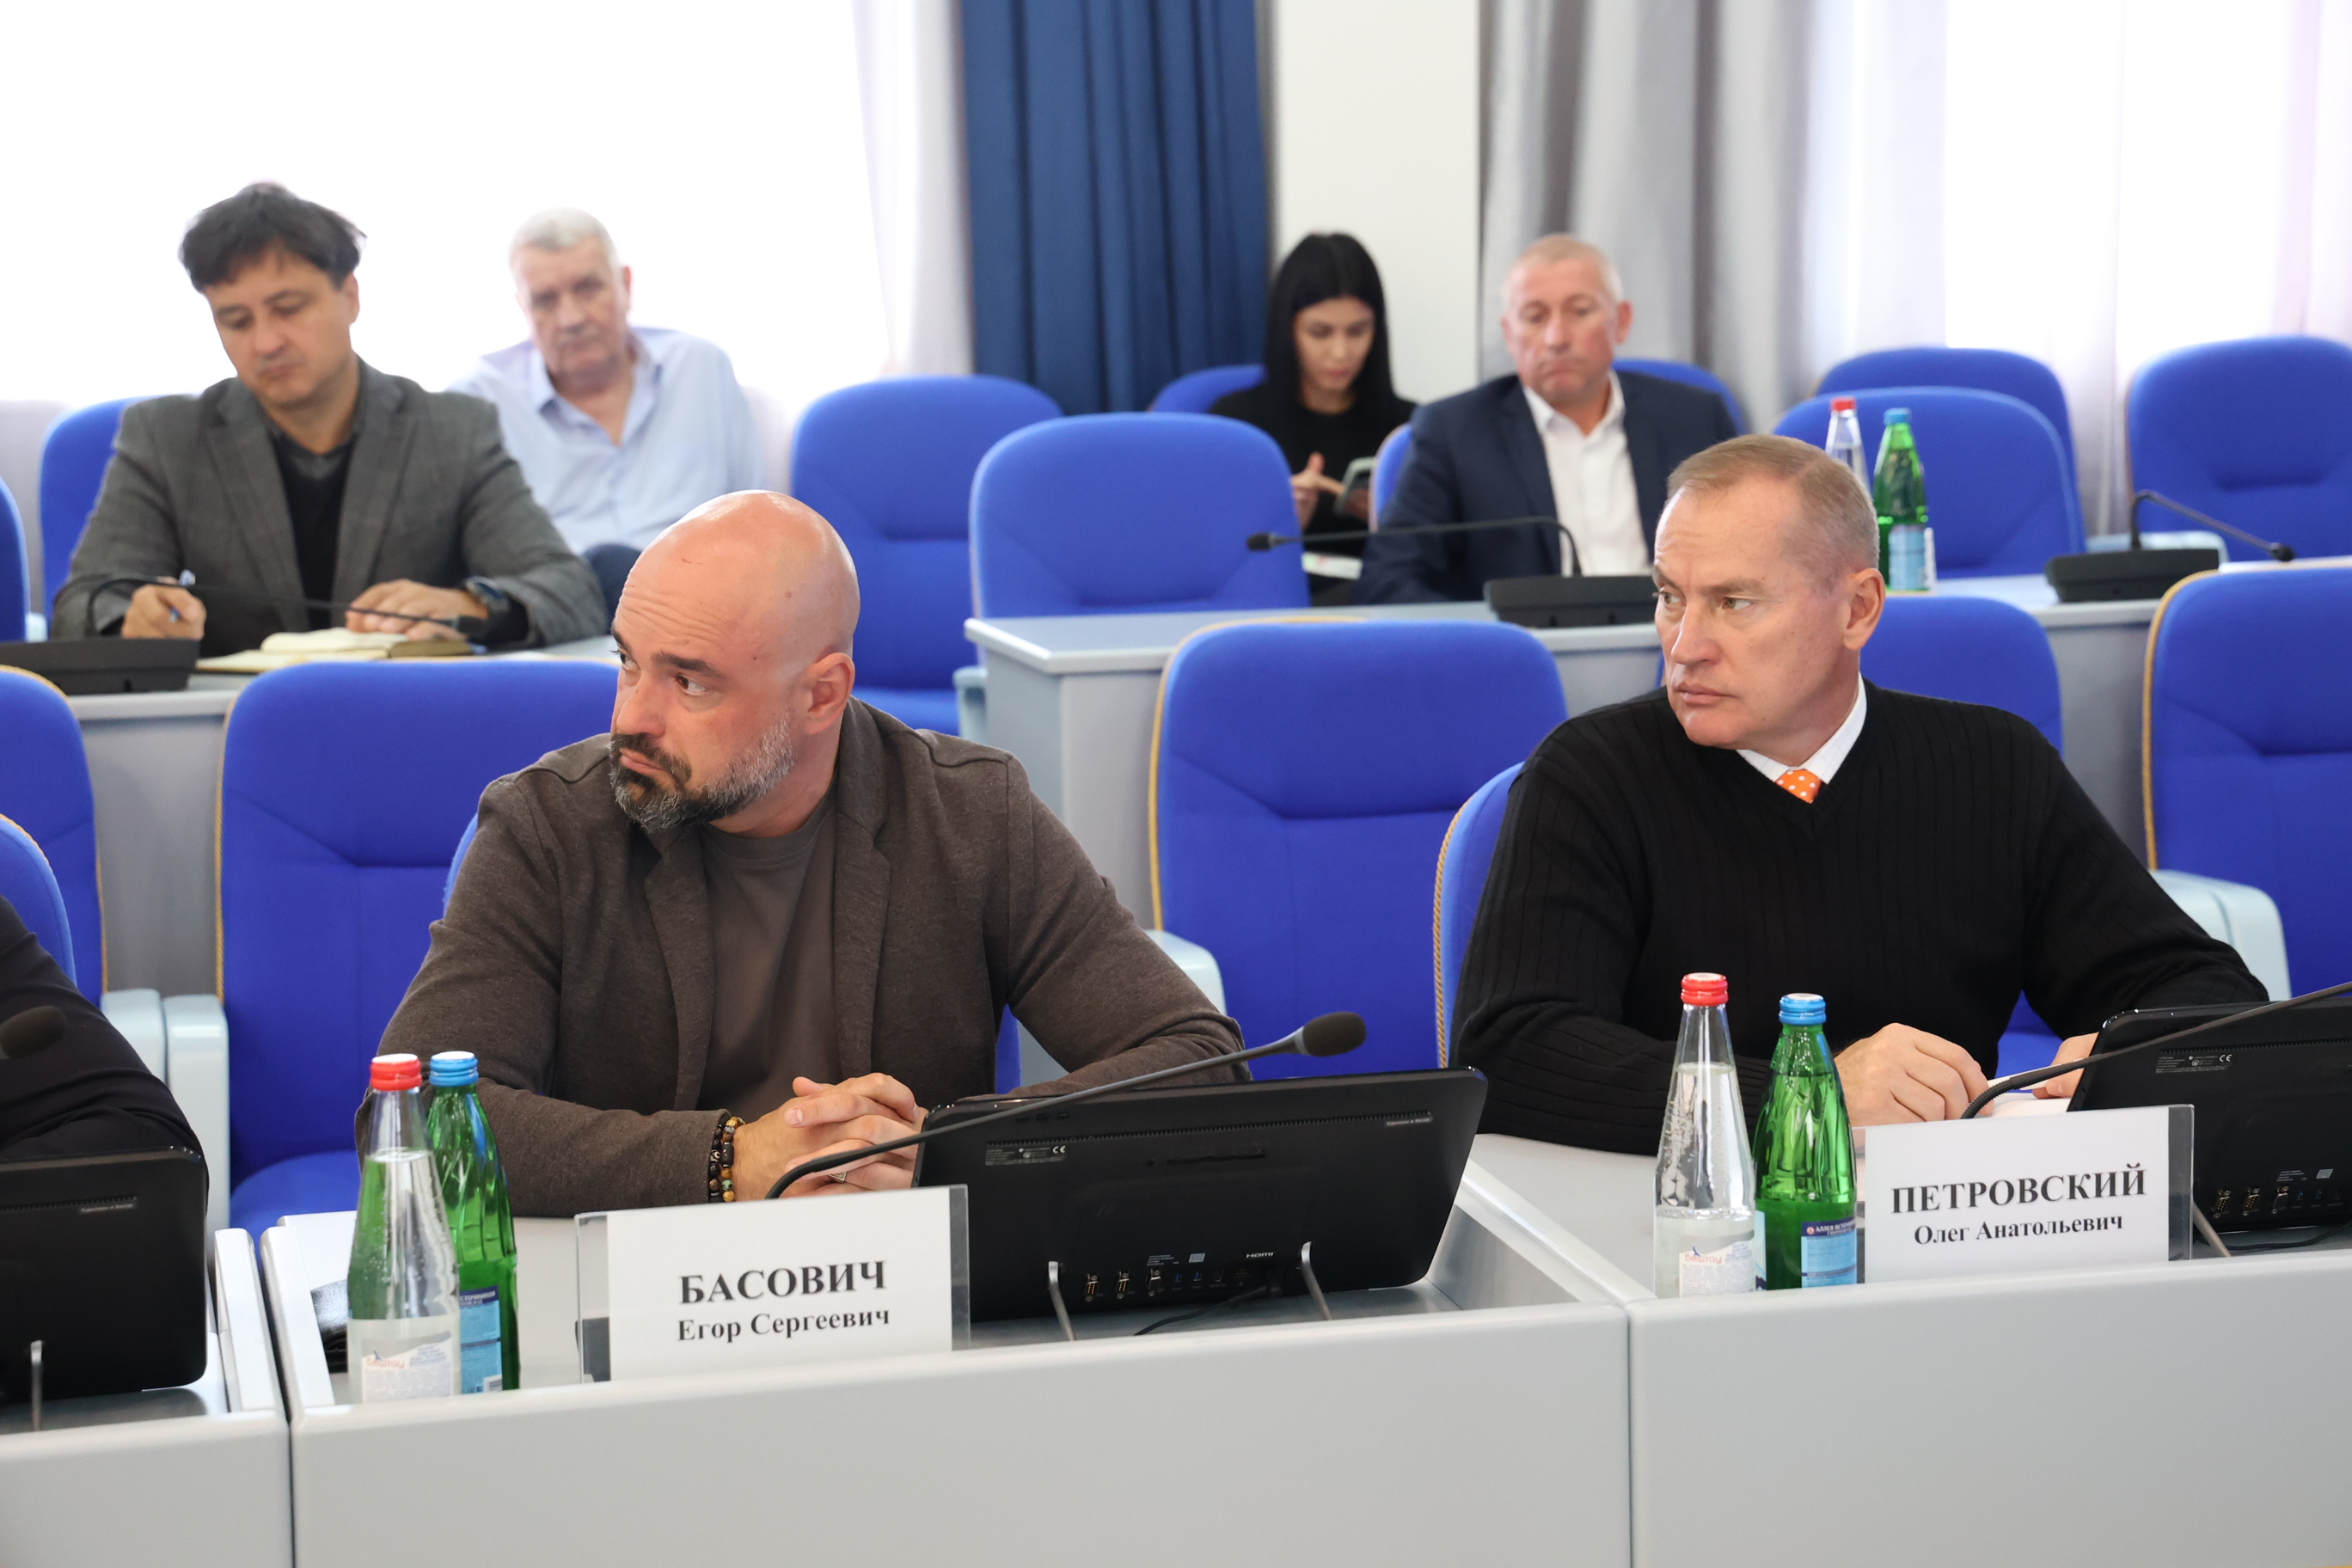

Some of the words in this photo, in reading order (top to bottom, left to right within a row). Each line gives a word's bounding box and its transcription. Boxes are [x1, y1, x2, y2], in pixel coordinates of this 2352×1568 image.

[1890, 1162, 2147, 1214] ПЕТРОВСКИЙ
[1914, 1225, 1970, 1246] Олег
[1975, 1216, 2124, 1240] Анатольевич
[678, 1260, 887, 1305] БАСОВИЧ
[677, 1319, 743, 1344] Егор
[750, 1309, 891, 1339] Сергеевич
